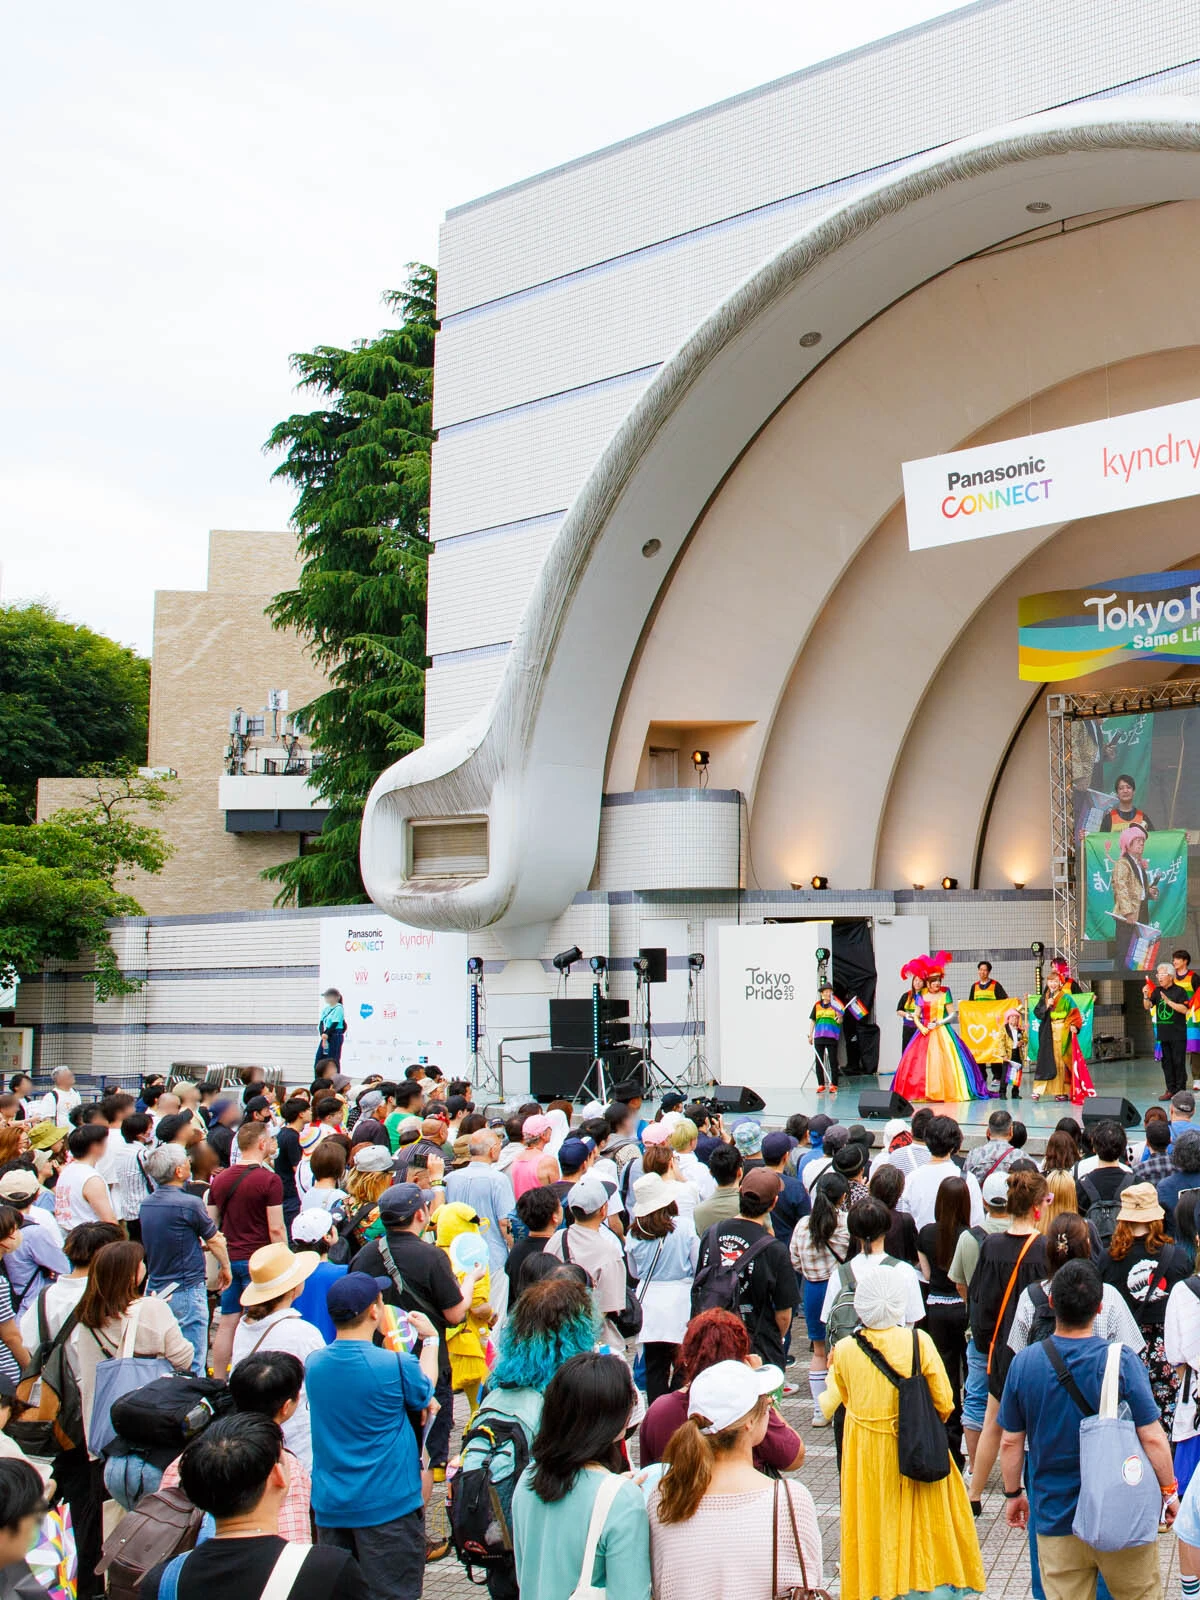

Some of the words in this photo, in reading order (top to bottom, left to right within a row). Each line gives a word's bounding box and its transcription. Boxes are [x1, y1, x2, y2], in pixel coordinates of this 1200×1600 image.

[948, 456, 1046, 490] Panasonic
[942, 479, 1053, 519] CONNECT
[1084, 593, 1185, 634] Tokyo
[1133, 634, 1178, 649] Same
[348, 930, 382, 939] Panasonic
[400, 931, 434, 950] kyndryl
[345, 941, 384, 952] CONNECT
[745, 967, 791, 988] Tokyo
[745, 985, 783, 1000] Pride
